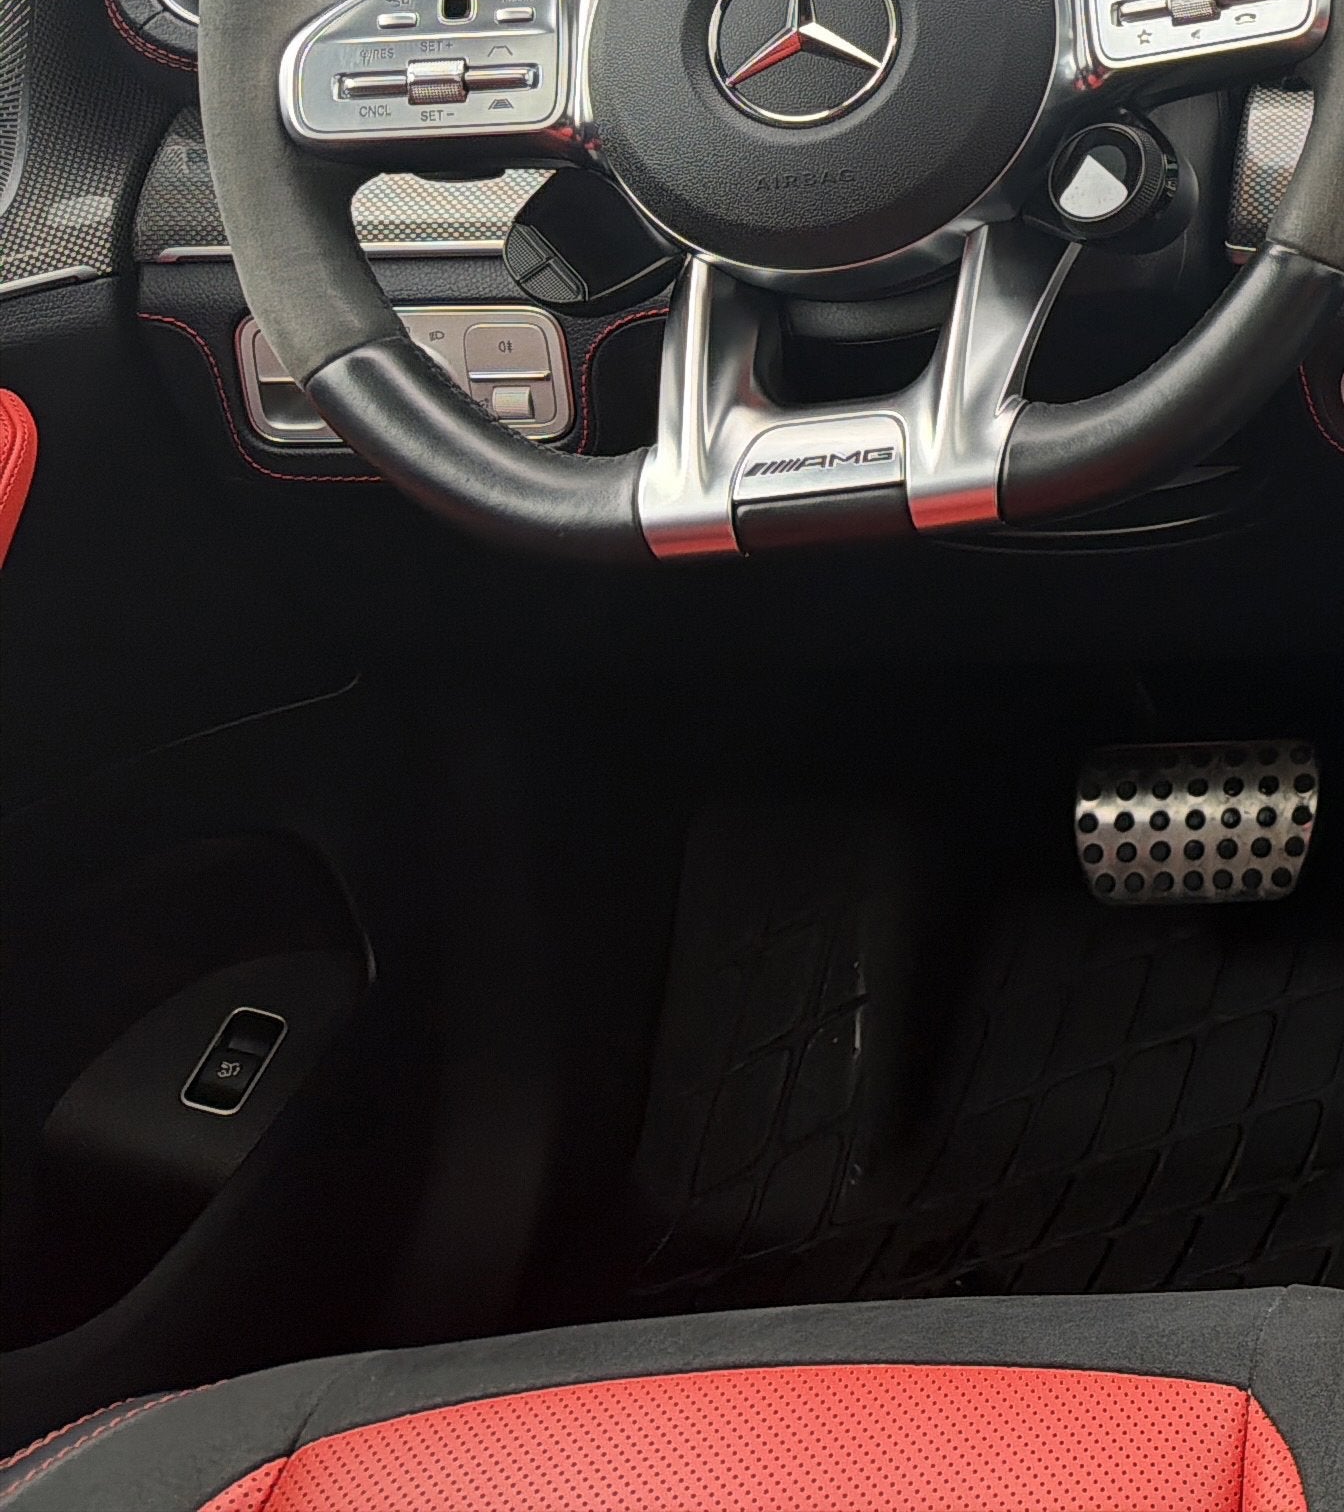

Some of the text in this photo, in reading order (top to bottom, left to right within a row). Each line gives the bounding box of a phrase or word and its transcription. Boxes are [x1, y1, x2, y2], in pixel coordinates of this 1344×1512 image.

[420, 41, 443, 52] SET
[359, 105, 391, 117] CNCL
[420, 110, 443, 122] SET
